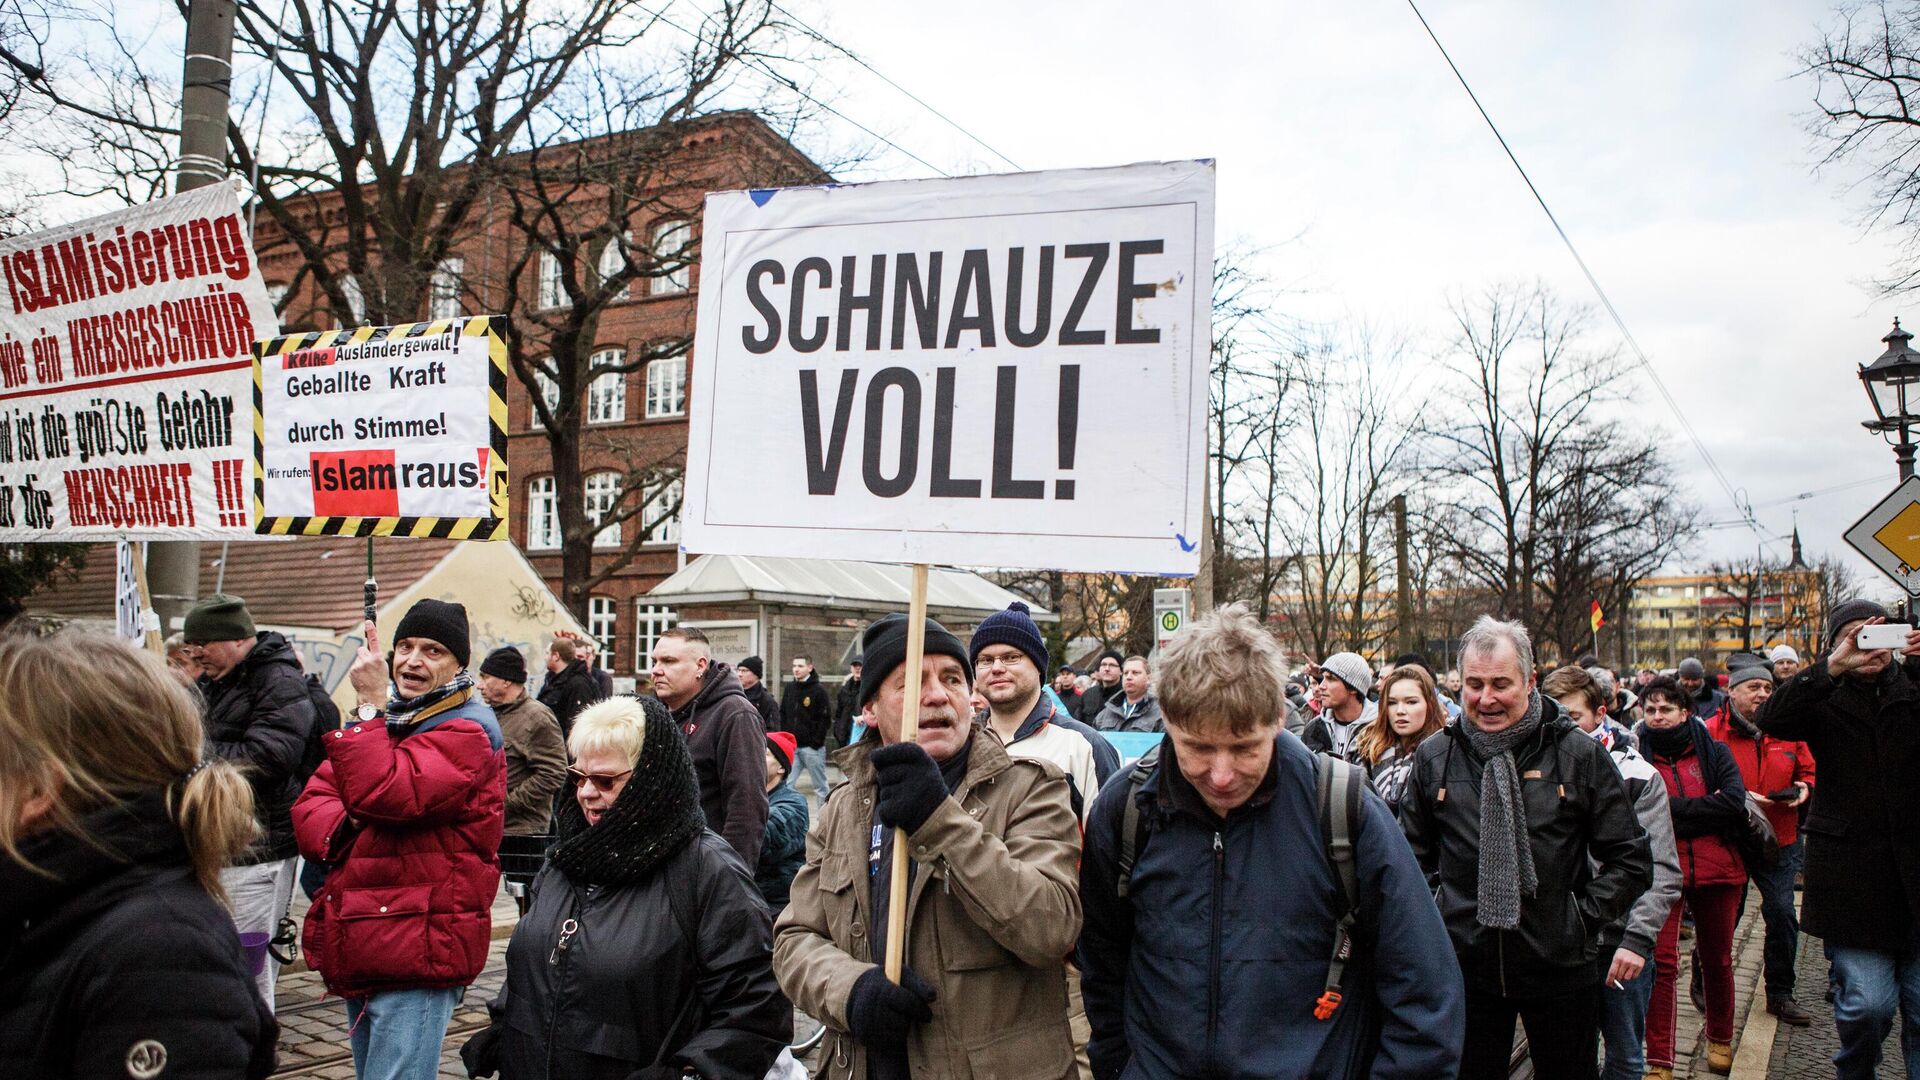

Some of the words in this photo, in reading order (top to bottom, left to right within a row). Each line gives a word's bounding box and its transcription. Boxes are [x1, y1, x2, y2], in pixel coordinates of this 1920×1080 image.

[2, 212, 251, 315] ISLAMisierung
[741, 238, 1164, 355] SCHNAUZE
[32, 327, 63, 384] ein
[67, 284, 254, 378] KREBSGESCHWÜR
[287, 371, 371, 398] Geballte
[390, 361, 446, 390] Kraft
[15, 408, 39, 462] ist
[41, 404, 70, 459] die
[75, 398, 147, 463] größte
[157, 389, 234, 452] Gefahr
[288, 418, 344, 443] durch
[354, 412, 447, 440] Stimme!
[798, 363, 1081, 500] VOLL!
[18, 473, 54, 530] die
[63, 463, 195, 528] MENSCHHEIT
[211, 458, 247, 528] !!!
[267, 467, 280, 479] Wir
[282, 466, 312, 479] rufen:
[312, 458, 397, 491] Islam
[402, 447, 490, 489] raus!
